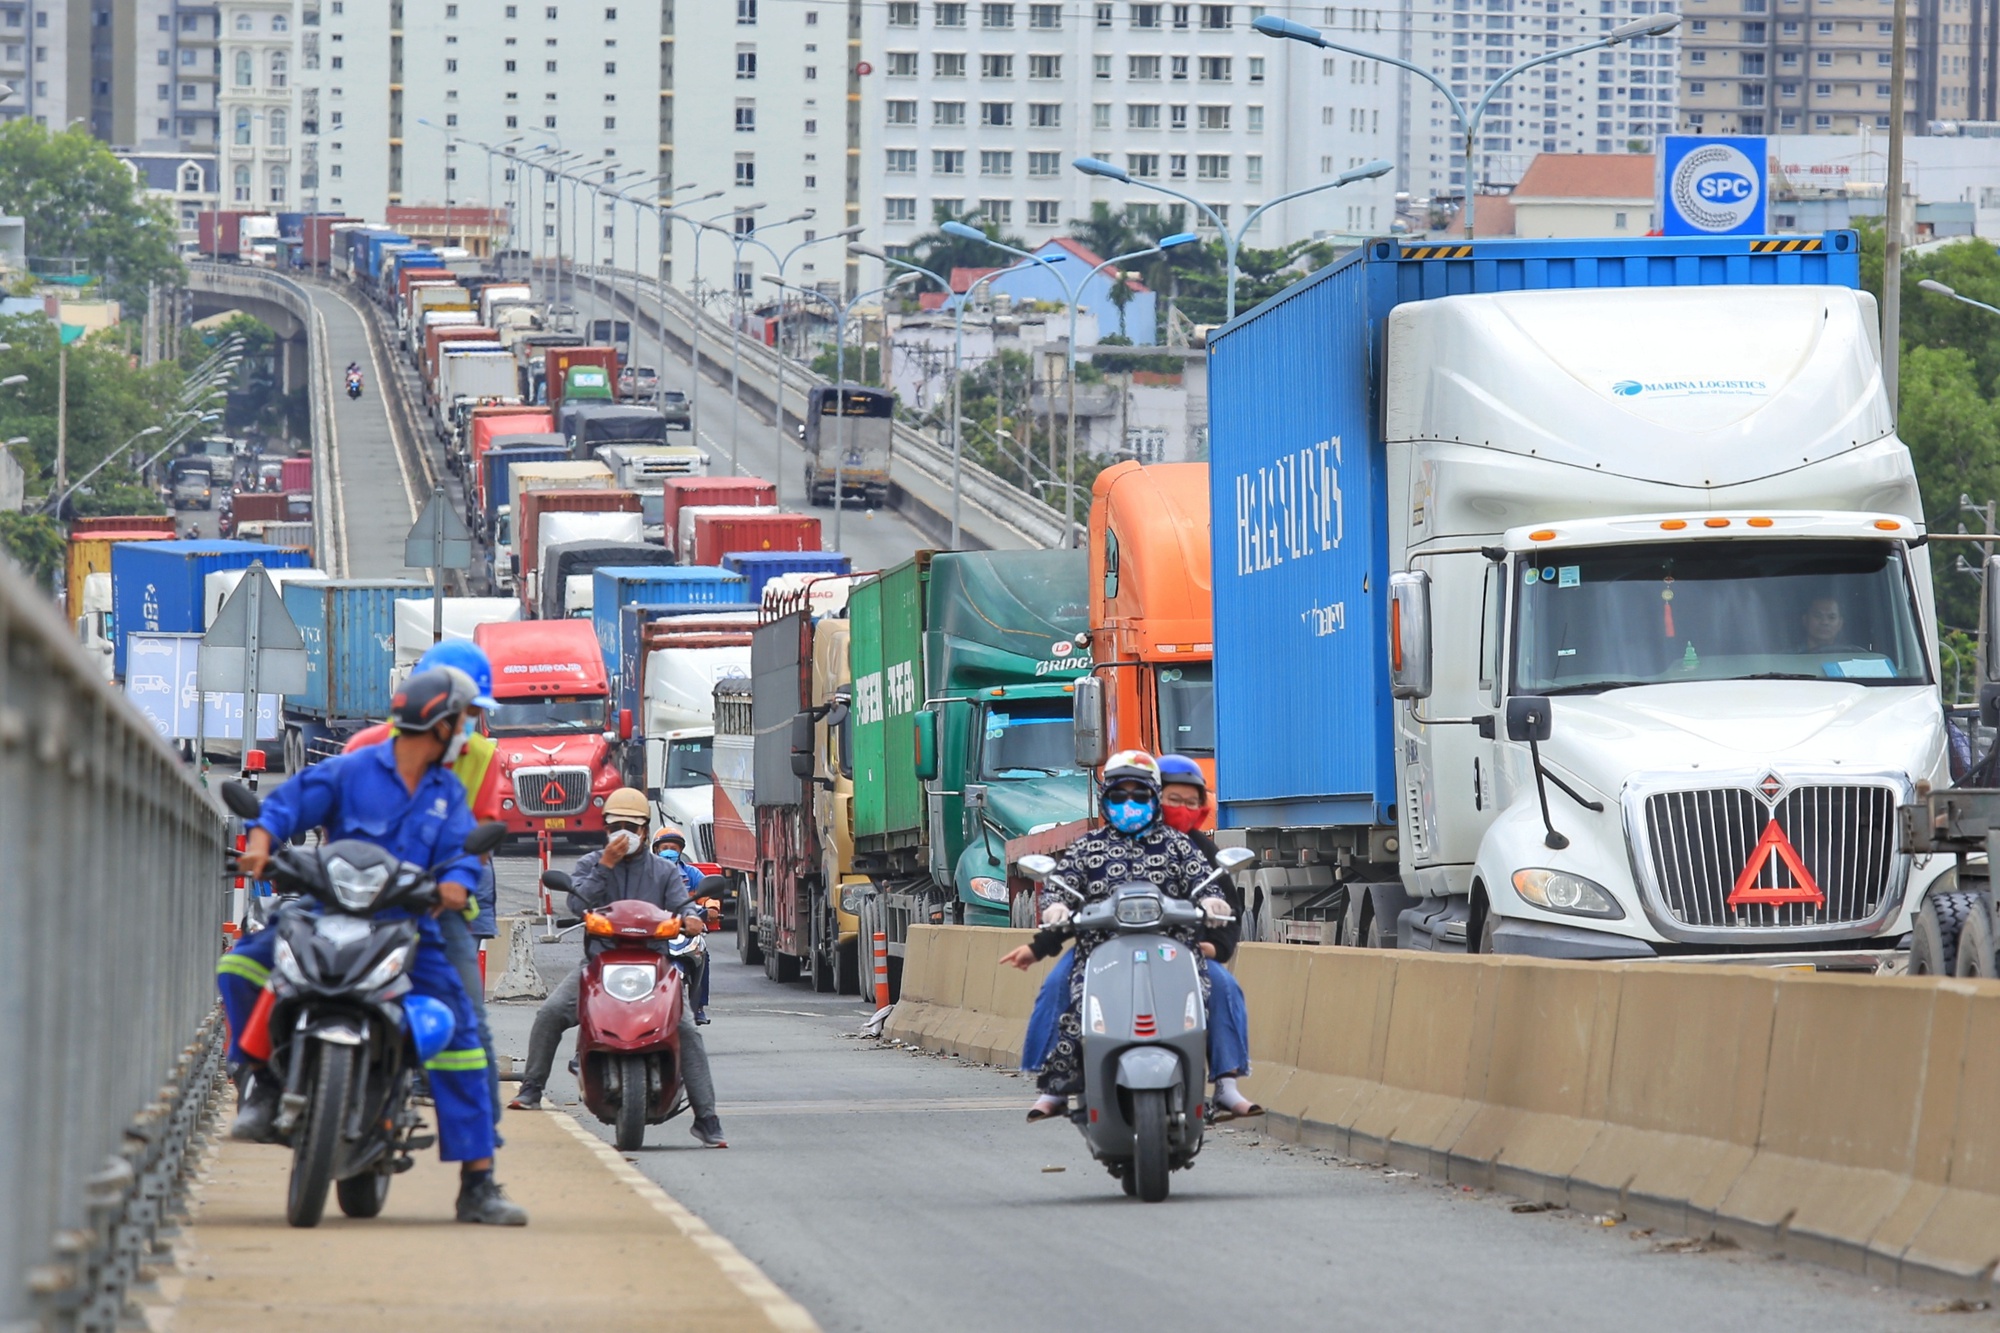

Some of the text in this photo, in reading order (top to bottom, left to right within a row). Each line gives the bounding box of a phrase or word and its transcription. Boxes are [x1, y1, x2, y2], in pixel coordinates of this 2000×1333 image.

[1700, 178, 1749, 198] SPC
[1644, 380, 1767, 392] MARINA LOGISTICS
[1035, 656, 1093, 677] BRIDG
